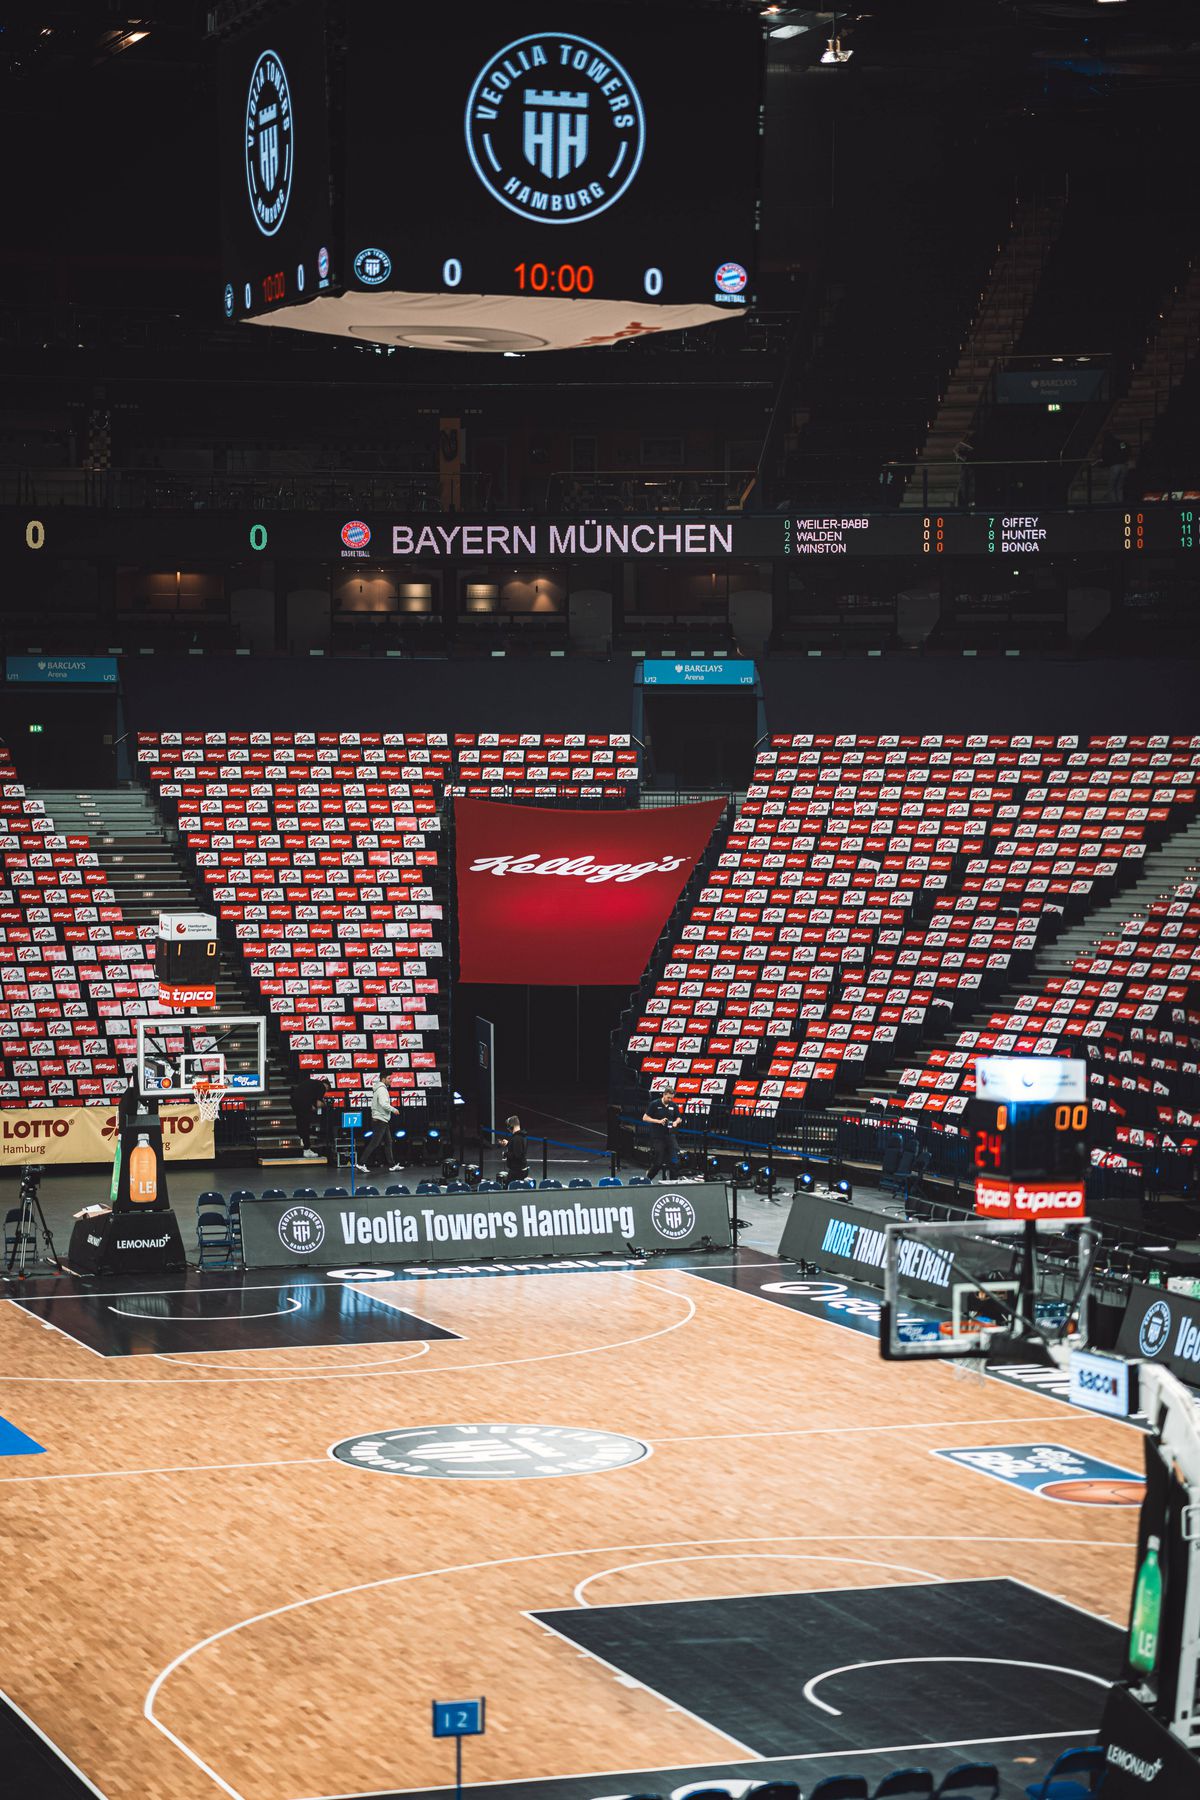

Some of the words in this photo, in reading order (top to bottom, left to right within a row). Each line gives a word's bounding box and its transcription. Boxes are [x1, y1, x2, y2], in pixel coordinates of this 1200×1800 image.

[475, 44, 548, 120] VEOLIA
[559, 44, 635, 129] TOWERS
[247, 66, 265, 148] VEOLIA
[266, 60, 291, 131] TOWERS
[523, 110, 589, 180] HH
[257, 188, 285, 224] HAMBURG
[503, 176, 605, 212] HAMBURG
[297, 263, 305, 292] 0
[443, 258, 463, 287] 0
[514, 262, 595, 293] 10:00
[643, 267, 664, 296] 0
[245, 282, 252, 310] 0
[262, 271, 286, 304] 10:00
[784, 519, 791, 530] 0
[796, 518, 869, 530] WEILER-BABB
[923, 517, 930, 528] 0
[936, 517, 944, 528] 0
[988, 517, 995, 528] 7
[1001, 517, 1039, 528] GIFFEY
[1124, 513, 1131, 525] 0
[1136, 513, 1144, 524] 0
[1180, 511, 1193, 523] 10
[1181, 524, 1192, 535] 11
[25, 520, 46, 550] 0
[249, 524, 268, 551] 0
[392, 525, 536, 555] BAYERN
[549, 519, 733, 554] MÜNCHEN
[784, 531, 791, 542] 2
[796, 531, 843, 542] WALDEN
[923, 529, 930, 540] 0
[936, 529, 944, 540] 0
[988, 530, 995, 541] 8
[1001, 529, 1047, 540] HUNTER
[1124, 526, 1131, 537] 0
[1136, 525, 1144, 537] 0
[988, 542, 995, 553] 9
[1001, 542, 1040, 552] BONGA
[1124, 538, 1131, 549] 0
[1136, 538, 1144, 549] 0
[1180, 537, 1193, 548] 13
[784, 543, 791, 554] 5
[796, 543, 847, 554] WINSTON
[923, 542, 930, 553] 0
[936, 542, 944, 553] 0
[47, 662, 86, 670] BARCLAYS
[47, 671, 68, 679] Arena
[684, 664, 723, 673] BARCLAYS
[740, 676, 753, 684] U13
[469, 853, 688, 884] Kellogg's
[206, 942, 217, 956] 0
[172, 988, 214, 1003] tipico
[996, 1105, 1008, 1132] 0
[1054, 1104, 1089, 1132] 00
[3, 1144, 46, 1155] Hamburg
[974, 1130, 1002, 1168] 24
[1014, 1186, 1083, 1214] tipico
[340, 1208, 419, 1245] Veolia
[421, 1208, 518, 1242] Towers
[521, 1202, 636, 1239] Hamburg
[821, 1218, 859, 1259] MORE
[852, 1226, 888, 1268] THAN
[403, 1257, 648, 1276] Schindler
